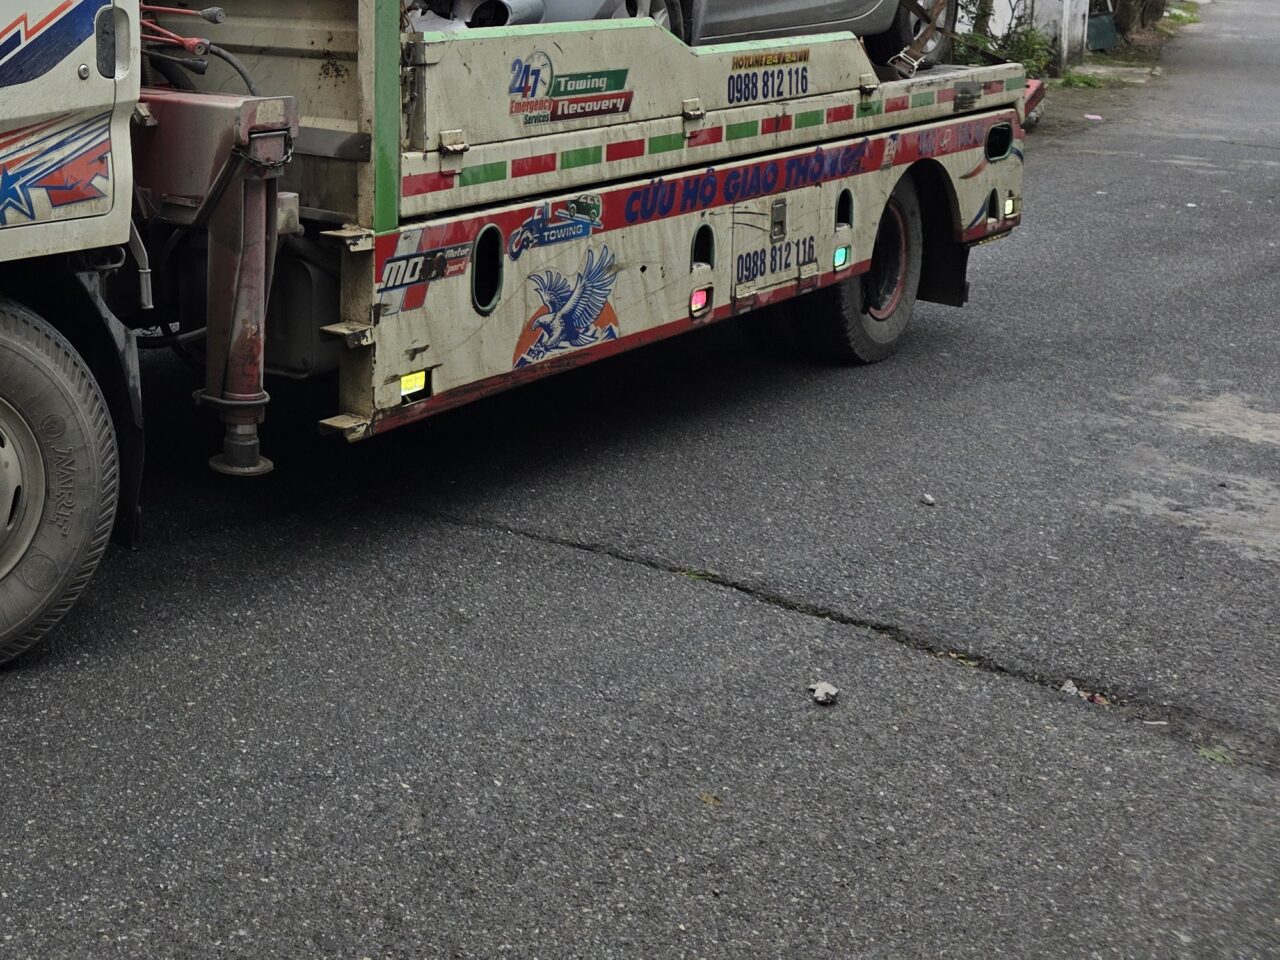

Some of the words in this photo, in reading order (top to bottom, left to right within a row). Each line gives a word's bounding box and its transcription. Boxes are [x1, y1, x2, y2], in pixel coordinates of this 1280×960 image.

[732, 54, 764, 70] HOTLINE
[558, 75, 607, 92] Towing
[728, 72, 758, 104] 0988
[762, 69, 784, 99] 812
[788, 66, 808, 95] 116
[511, 98, 553, 114] Emergency
[557, 97, 625, 115] Recovery
[524, 112, 549, 125] Services
[625, 176, 675, 224] CỨU
[679, 165, 718, 213] HỘ
[724, 163, 779, 205] GIAO
[543, 224, 583, 242] TOWING
[445, 246, 470, 259] Motor
[736, 249, 767, 284] 0988
[770, 244, 791, 274] 812
[796, 236, 815, 267] 116
[445, 260, 466, 276] port
